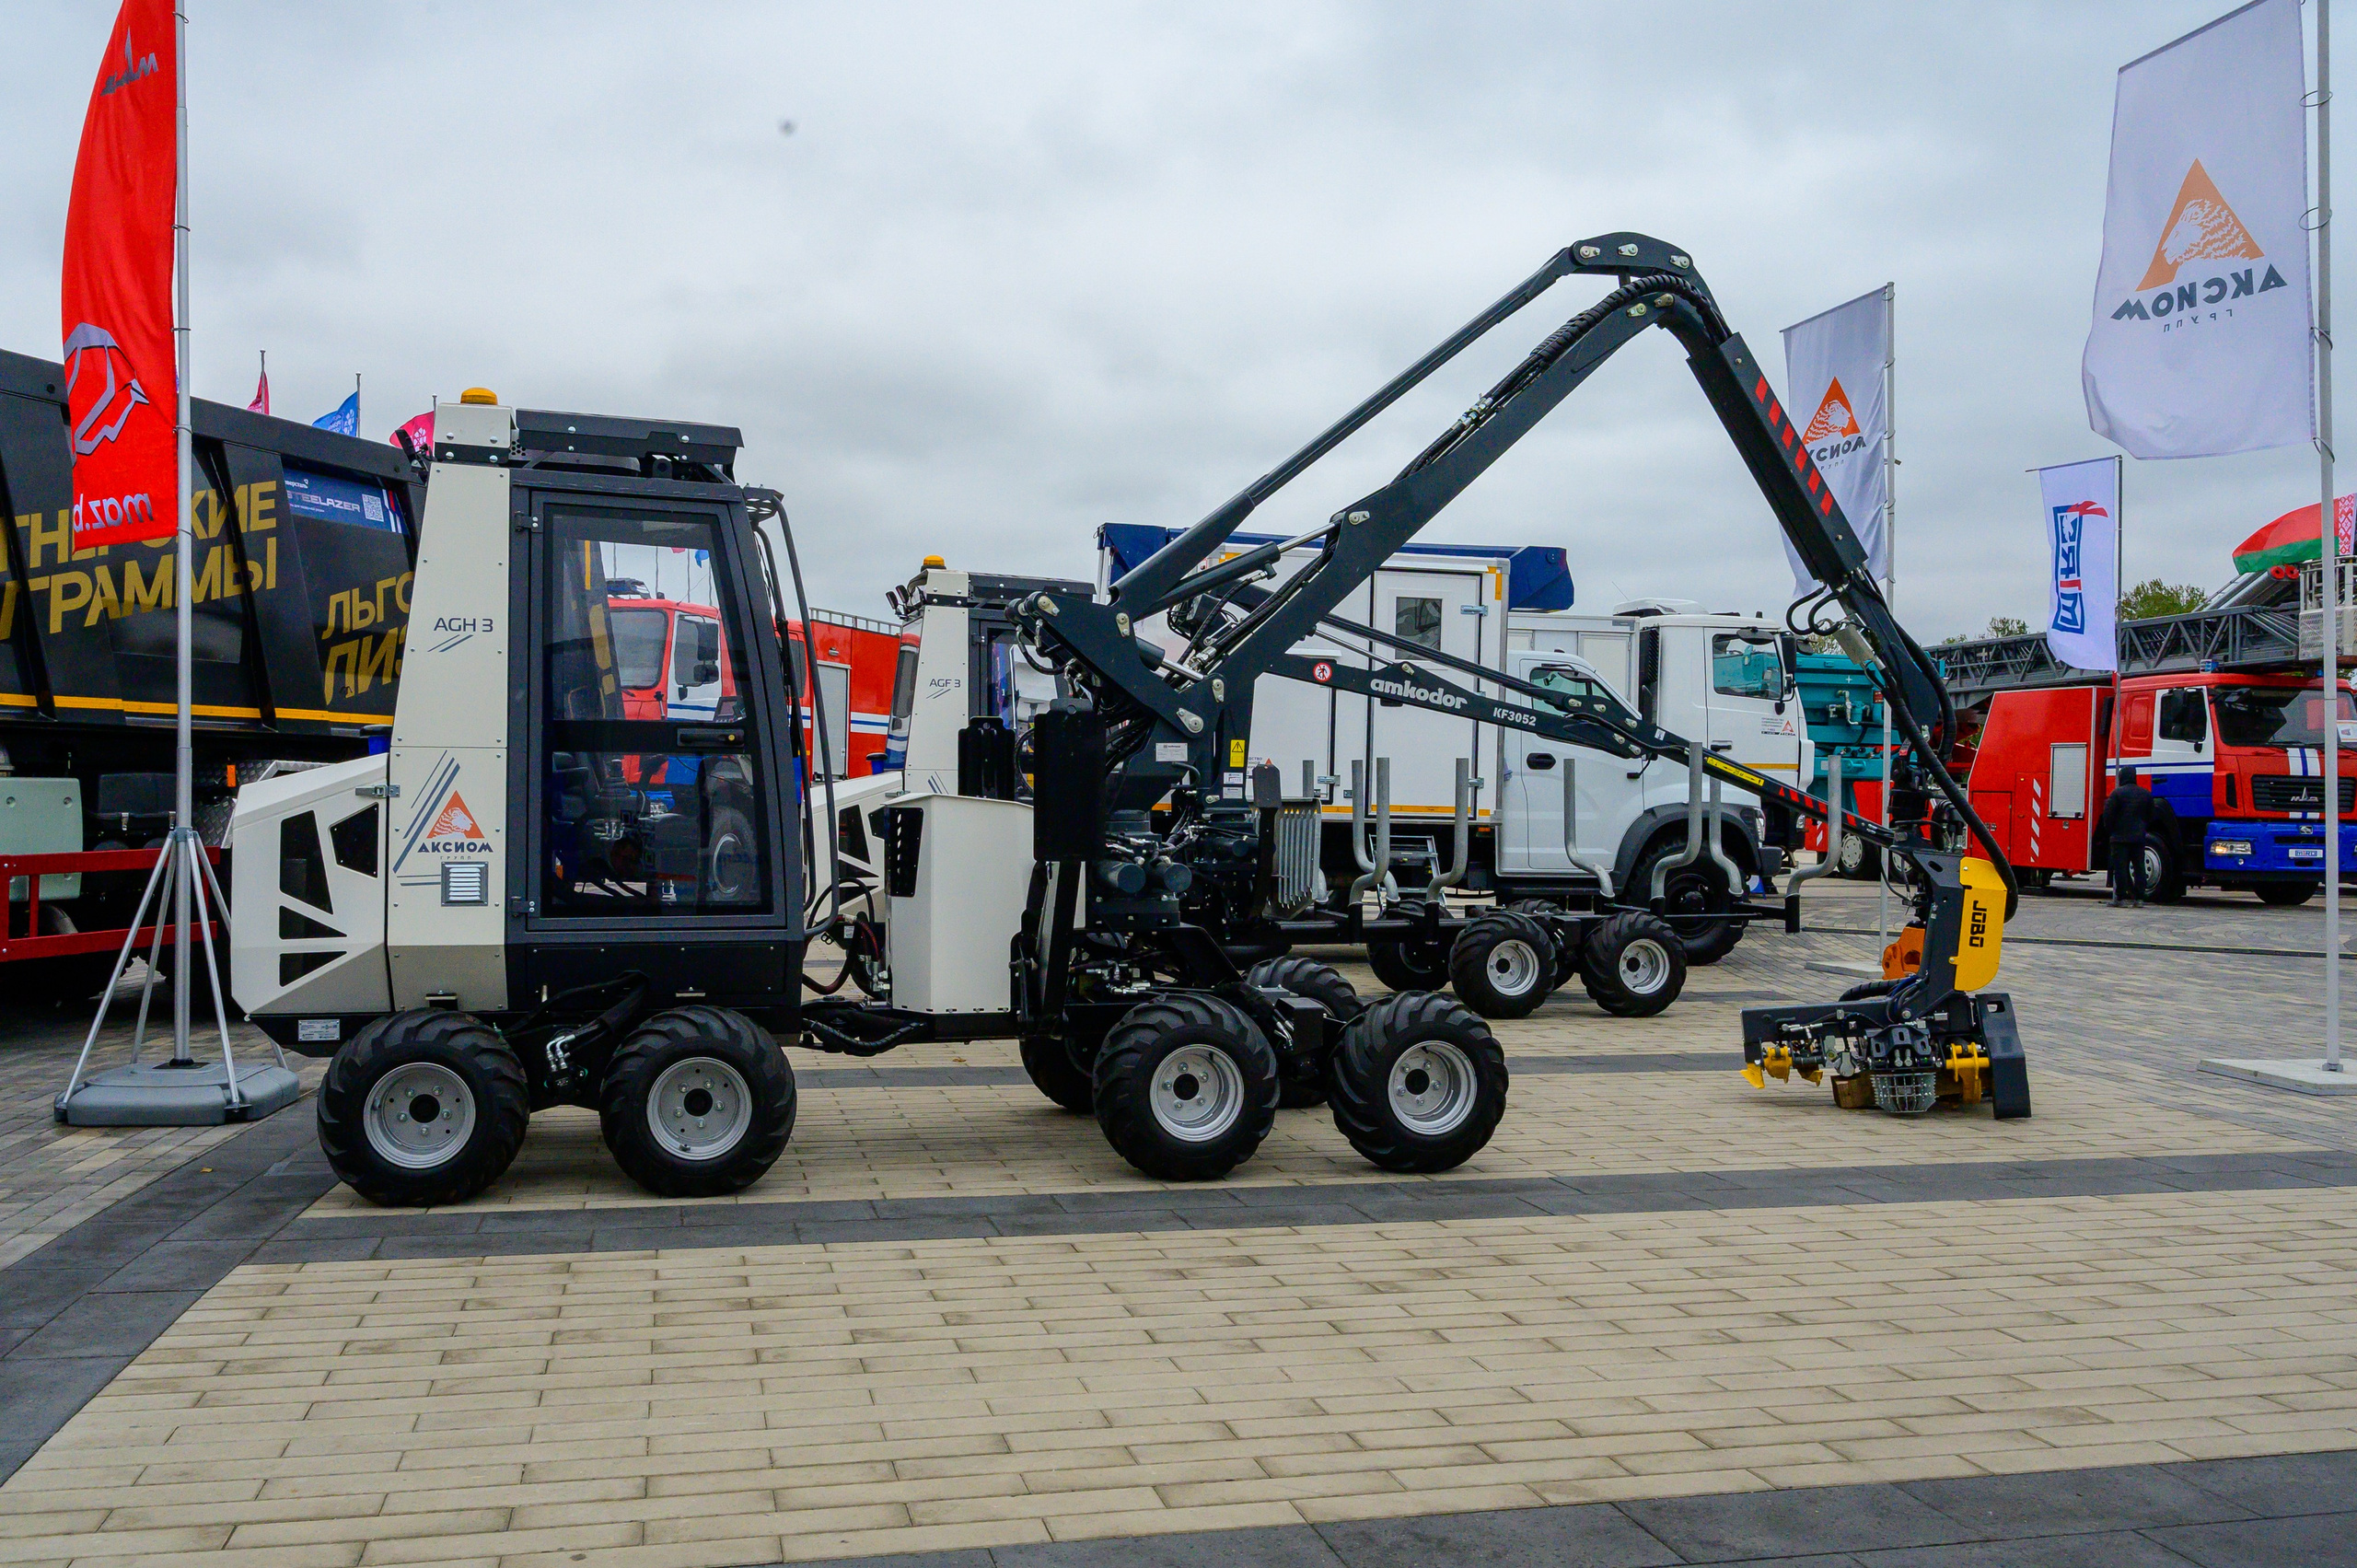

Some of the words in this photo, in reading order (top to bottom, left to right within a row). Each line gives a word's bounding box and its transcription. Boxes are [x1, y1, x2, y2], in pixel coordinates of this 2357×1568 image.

[433, 617, 476, 633] AGH
[482, 618, 493, 633] 3
[929, 678, 953, 688] AGF
[954, 679, 961, 688] 3
[1370, 678, 1469, 710] amkodor
[1492, 706, 1538, 727] KF3052
[417, 842, 494, 854] АКСИОМ
[1968, 900, 1988, 948] JOBO
